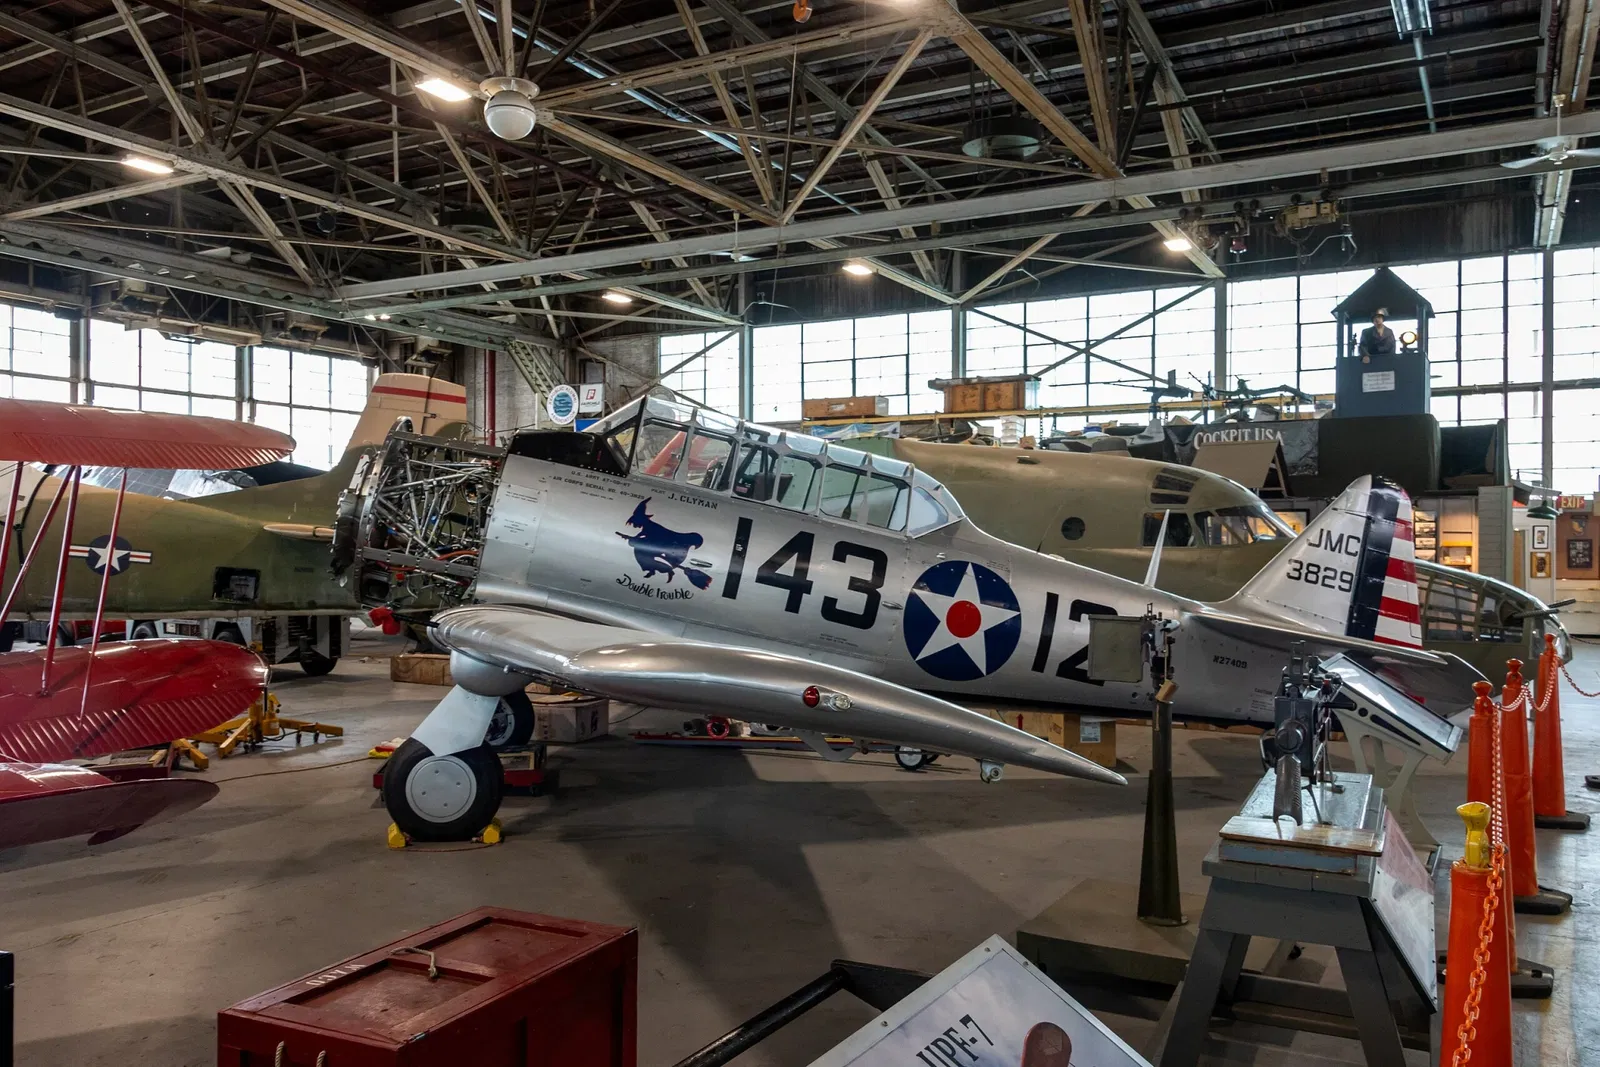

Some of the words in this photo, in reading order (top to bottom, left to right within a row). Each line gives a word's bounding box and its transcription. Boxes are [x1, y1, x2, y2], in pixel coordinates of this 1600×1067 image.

[1193, 428, 1251, 450] COCKPIT
[1254, 427, 1284, 446] USA
[564, 478, 583, 486] CORPS
[586, 483, 604, 491] SERIAL
[680, 495, 718, 510] CLYMAN
[1561, 495, 1580, 509] EXIT
[1306, 528, 1361, 557] JMC
[722, 516, 888, 630] 143
[1286, 558, 1354, 593] 3829
[615, 573, 654, 598] Double
